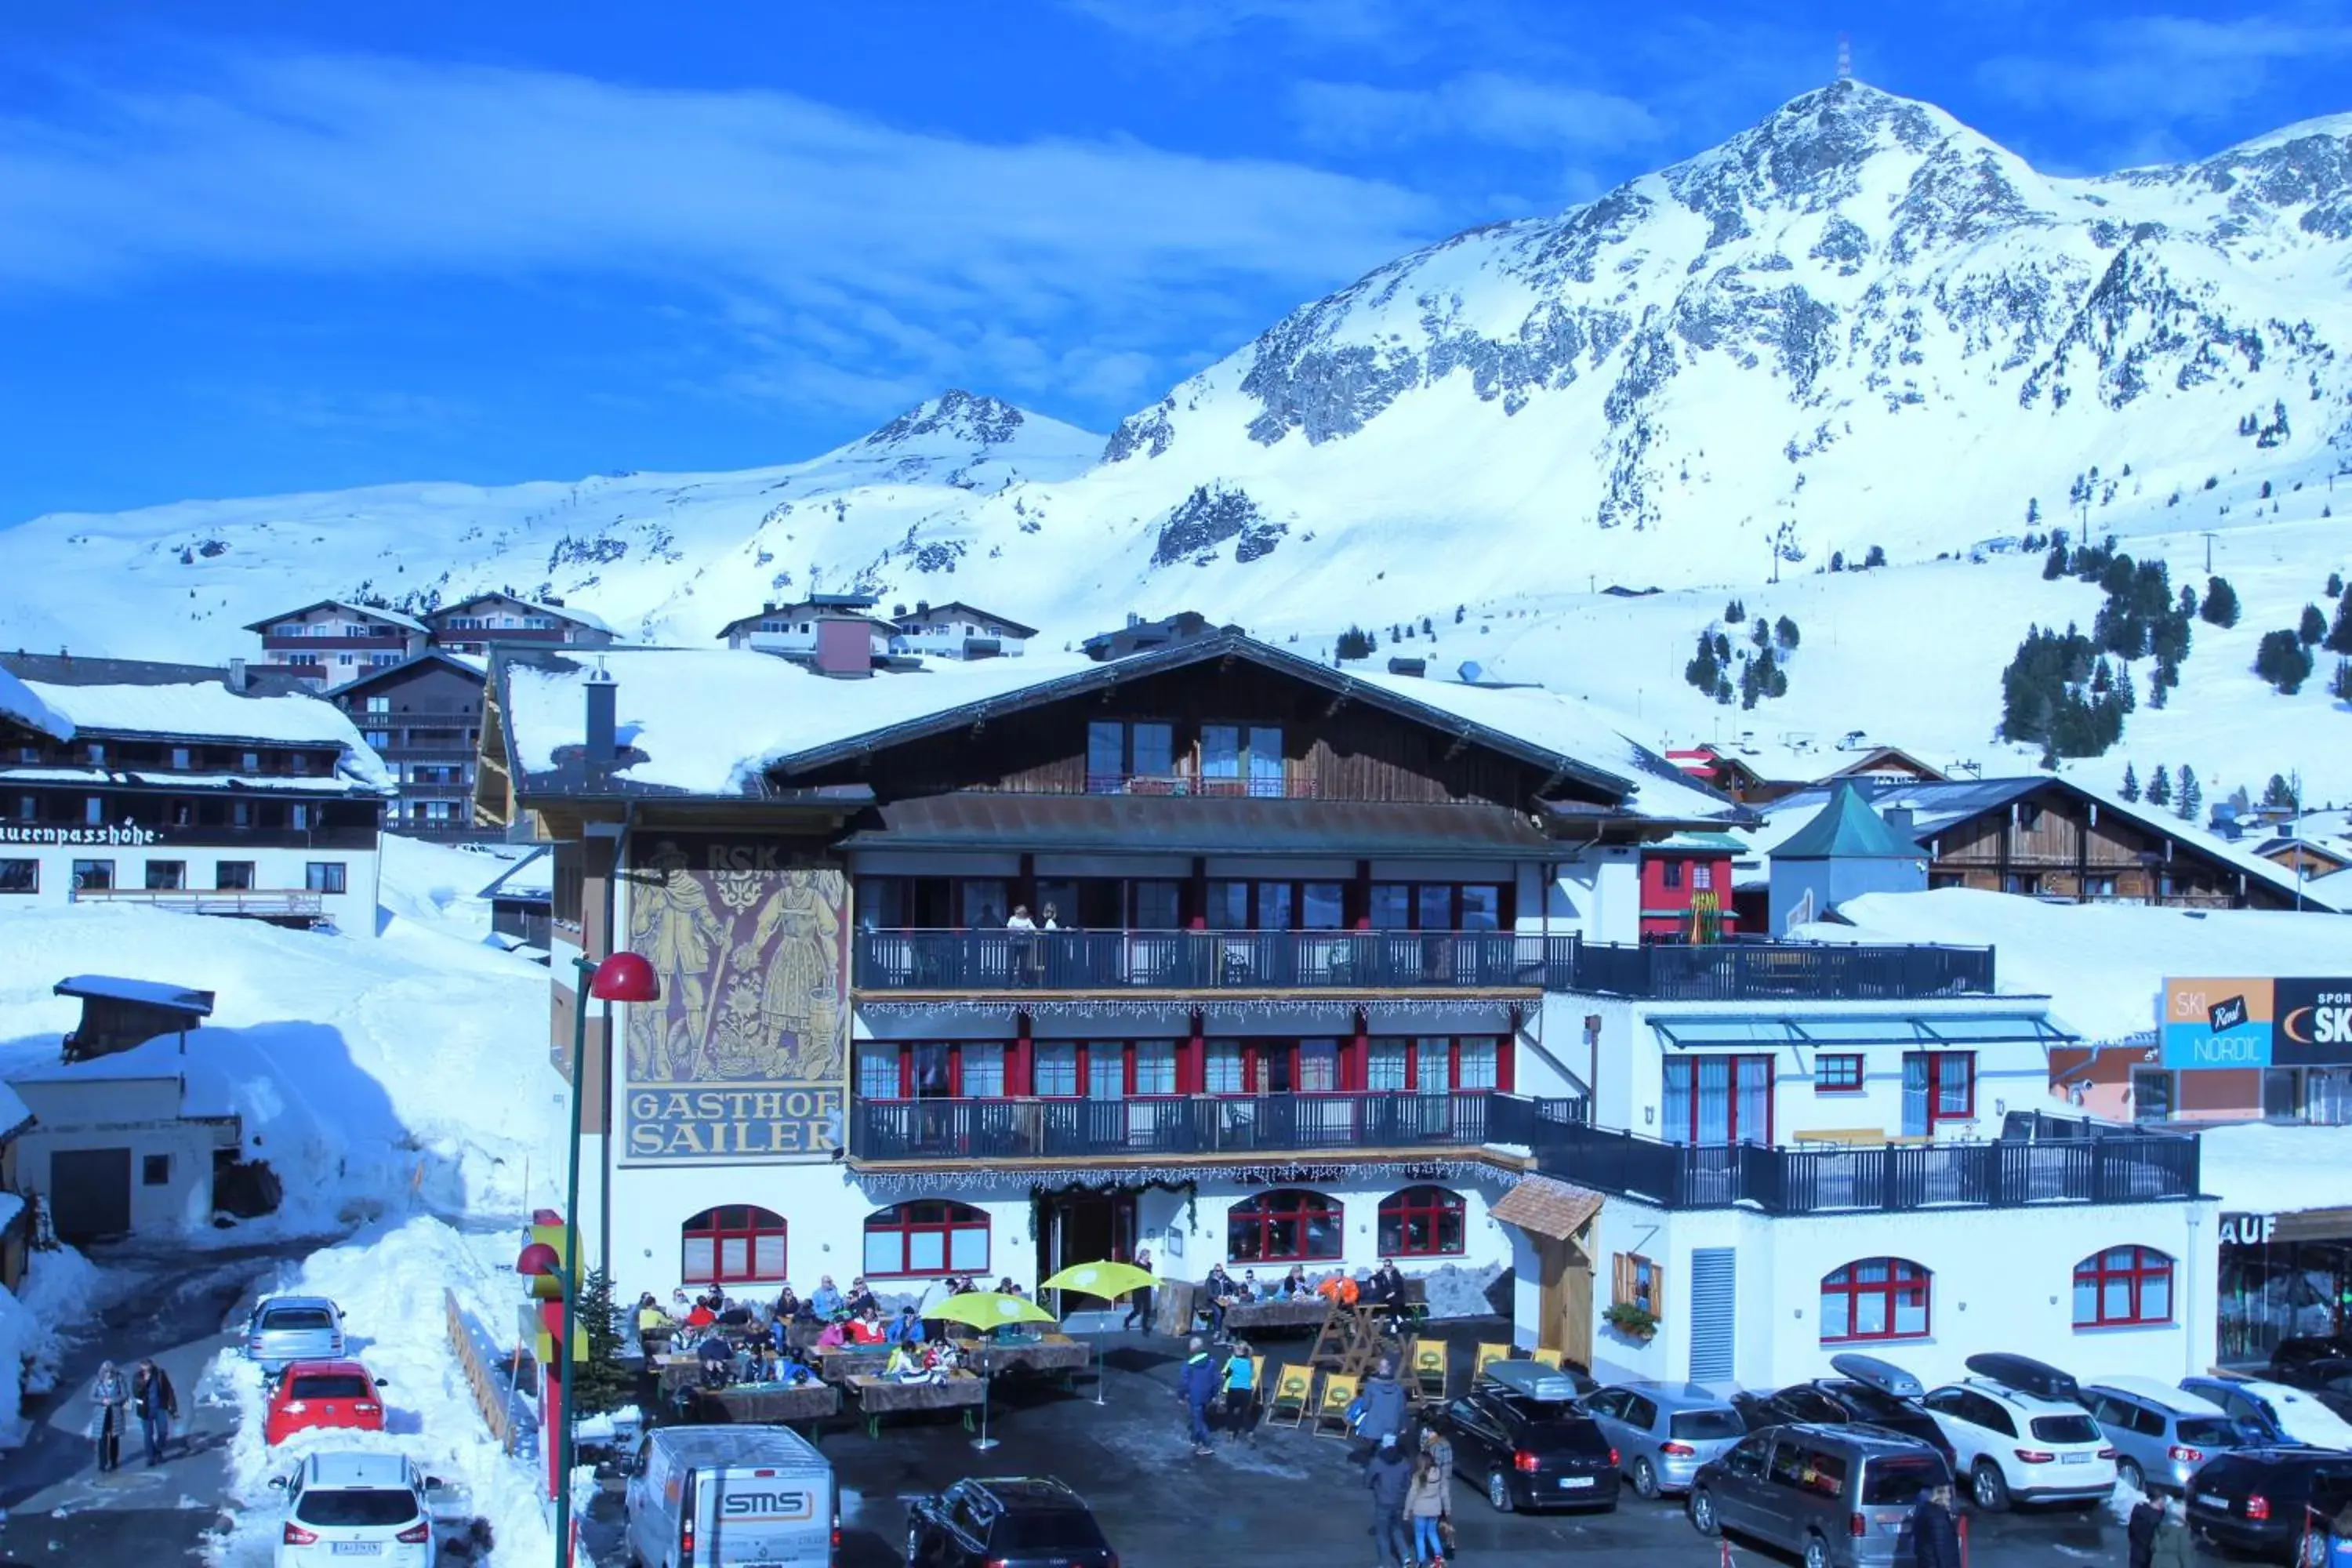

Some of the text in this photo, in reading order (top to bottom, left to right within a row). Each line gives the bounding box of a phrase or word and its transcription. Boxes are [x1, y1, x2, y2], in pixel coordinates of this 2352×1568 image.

[2176, 992, 2205, 1016] SKI
[2194, 1036, 2262, 1062] NORDIC
[630, 1091, 840, 1120] GASTHOF
[630, 1120, 837, 1154] SAILER
